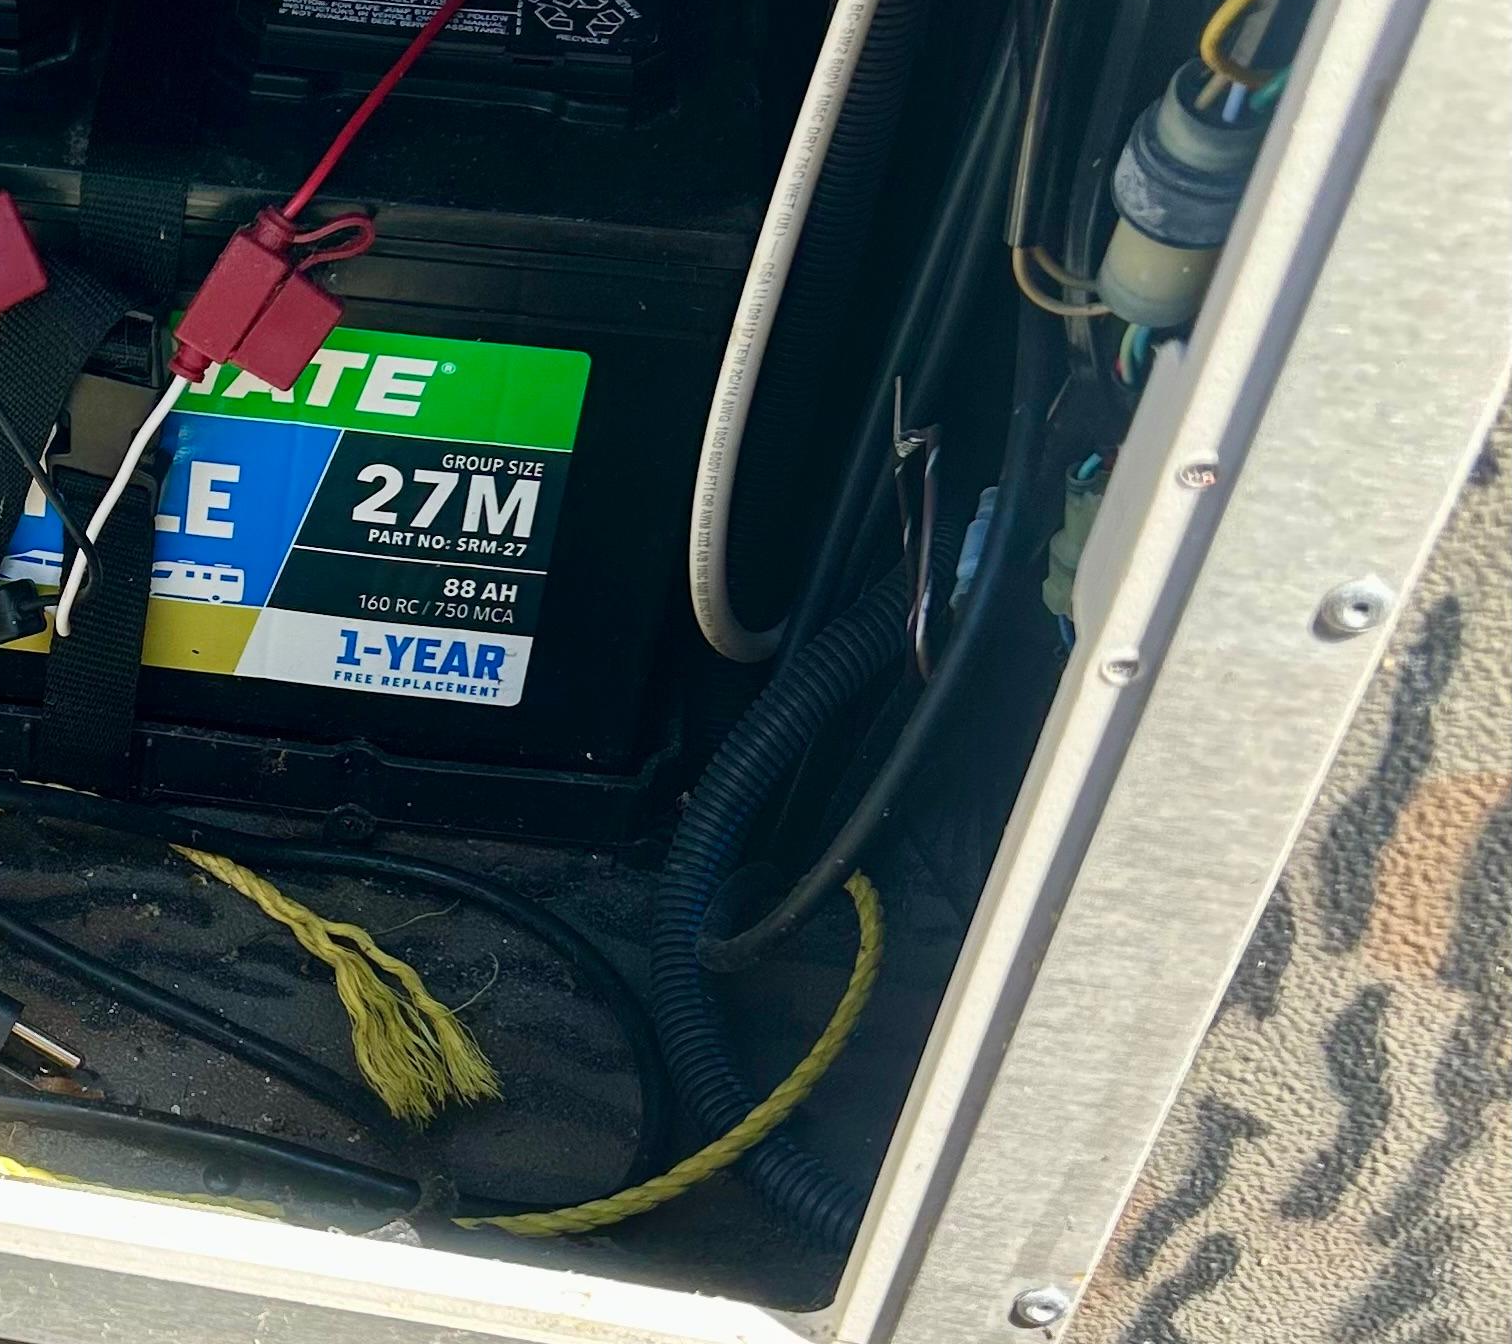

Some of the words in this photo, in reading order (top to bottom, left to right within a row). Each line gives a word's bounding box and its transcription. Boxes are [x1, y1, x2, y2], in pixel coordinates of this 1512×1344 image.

[556, 33, 609, 45] RECYCLE
[800, 124, 821, 152] DRY
[780, 179, 802, 209] WET
[756, 260, 776, 287] CSA
[716, 398, 735, 424] AWG
[442, 454, 504, 471] GROUP
[507, 460, 544, 477] SIZE
[352, 463, 541, 538] 27M
[368, 529, 413, 546] PART
[417, 534, 452, 550] NO:
[456, 538, 527, 556] SRM-27
[443, 579, 476, 598] 88
[481, 583, 518, 602] AH
[358, 594, 390, 611] 160
[395, 598, 417, 615] RC
[434, 602, 468, 618] 750
[473, 606, 514, 624] MCA
[336, 629, 506, 681] 1-YEAR
[334, 670, 372, 684] FREE
[381, 676, 500, 697] REPLACEMENT
